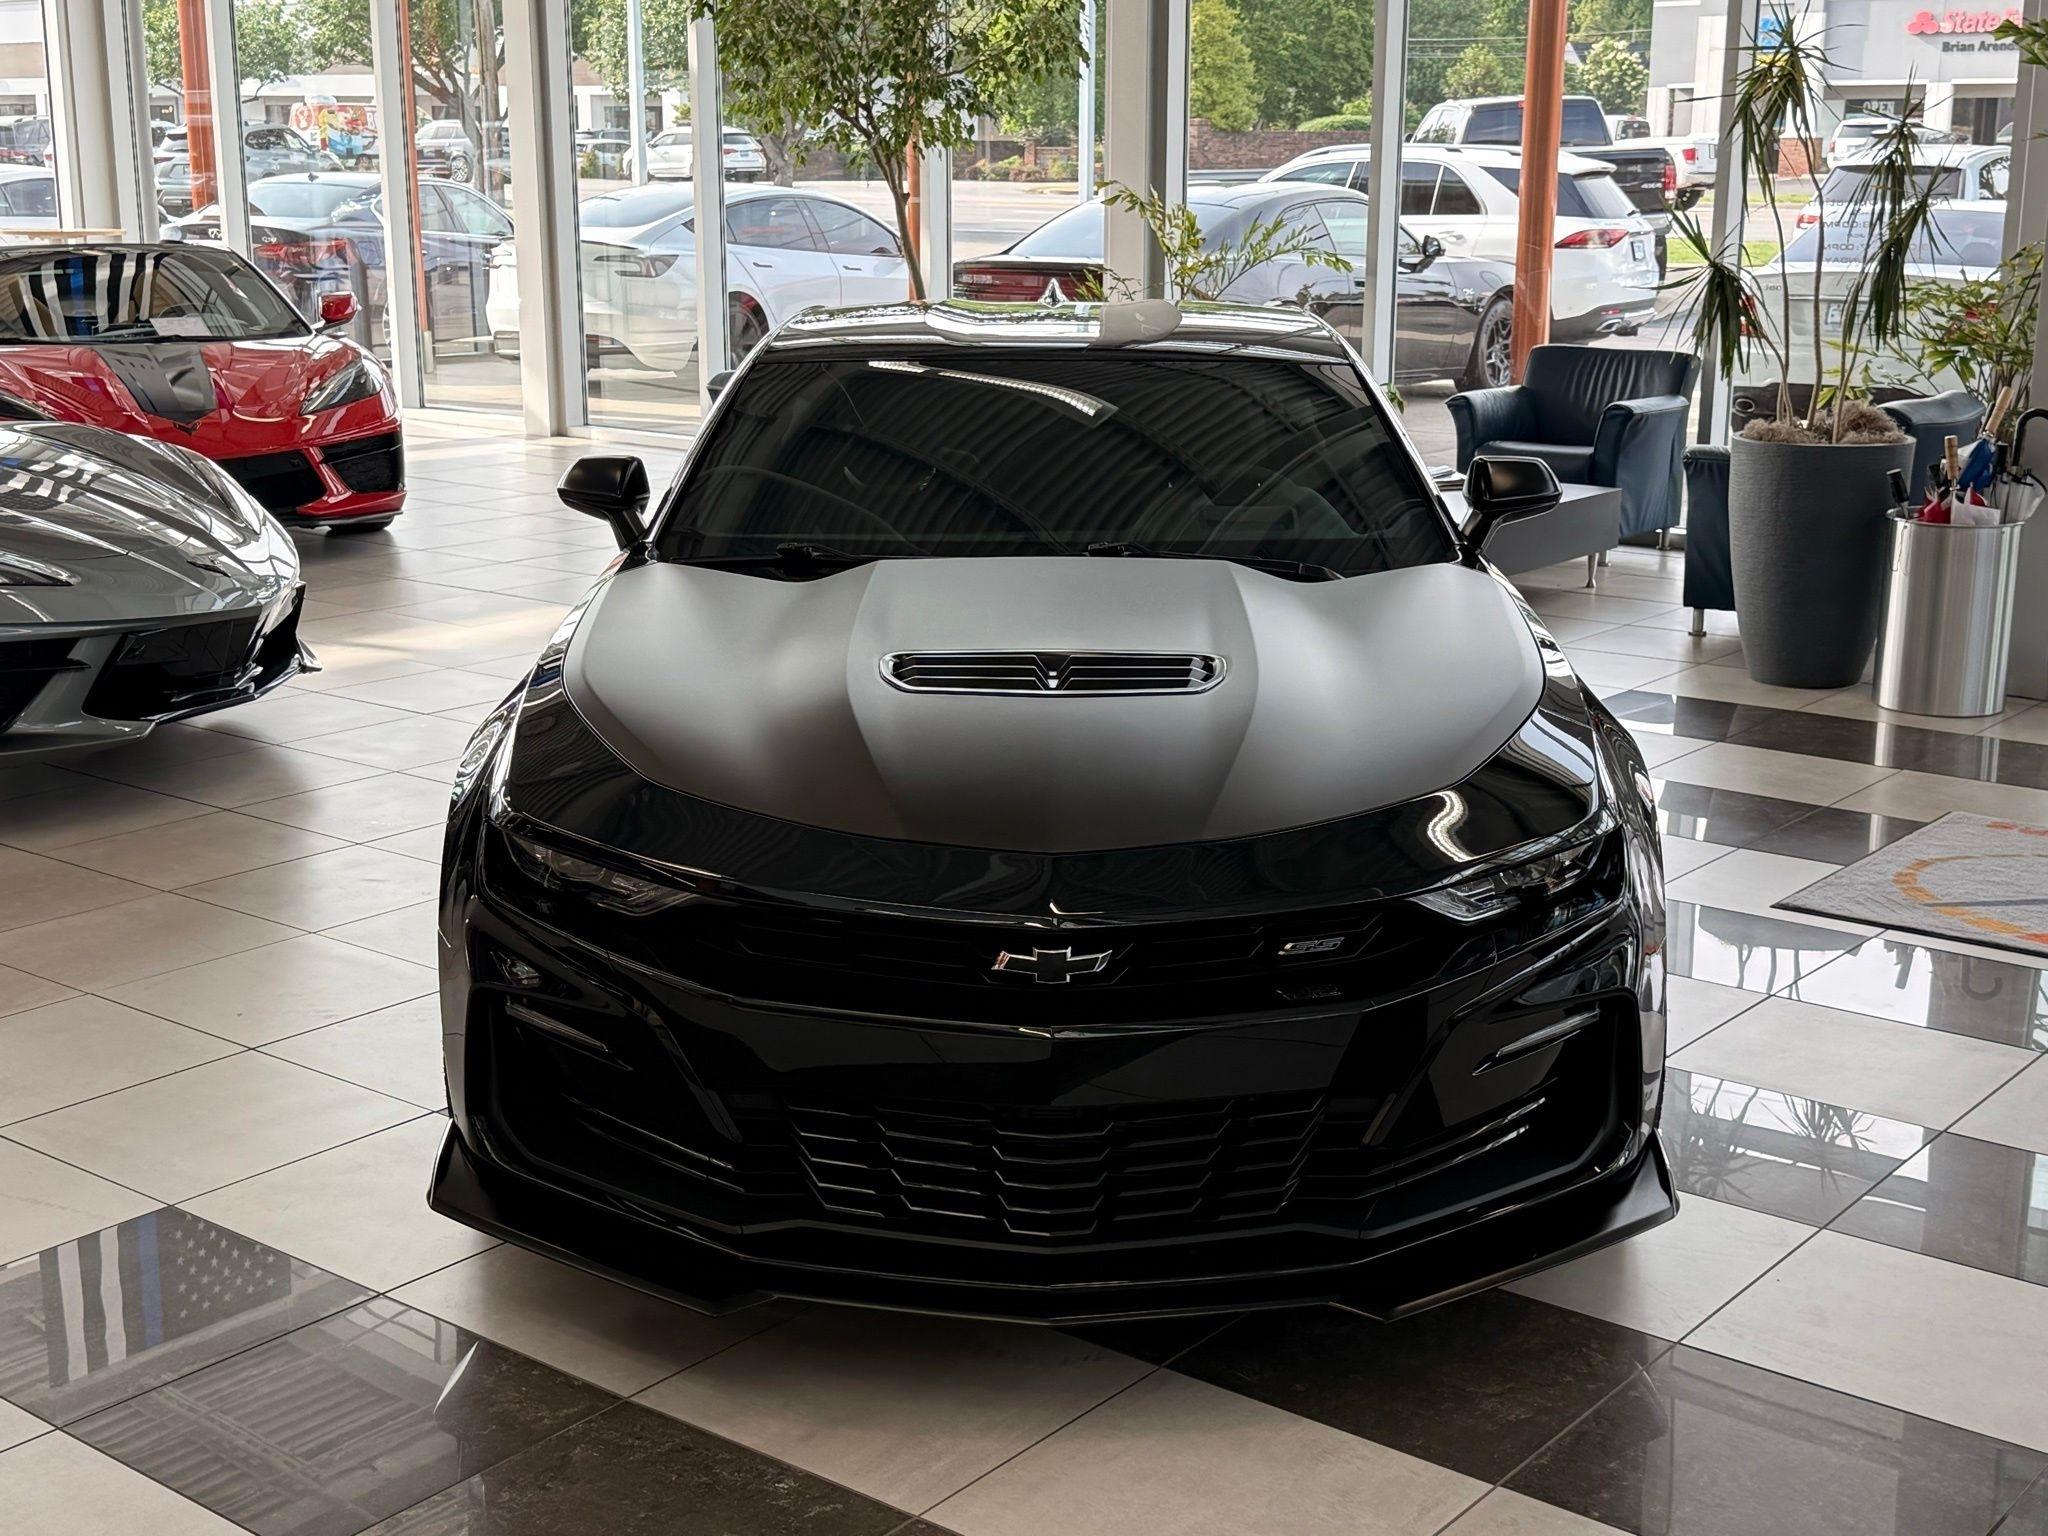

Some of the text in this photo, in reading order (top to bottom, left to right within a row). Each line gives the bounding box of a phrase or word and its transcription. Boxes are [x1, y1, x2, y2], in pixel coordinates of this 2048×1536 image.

[1940, 9, 2000, 32] State
[1942, 41, 1975, 53] Brian
[1862, 100, 1896, 115] OPEN
